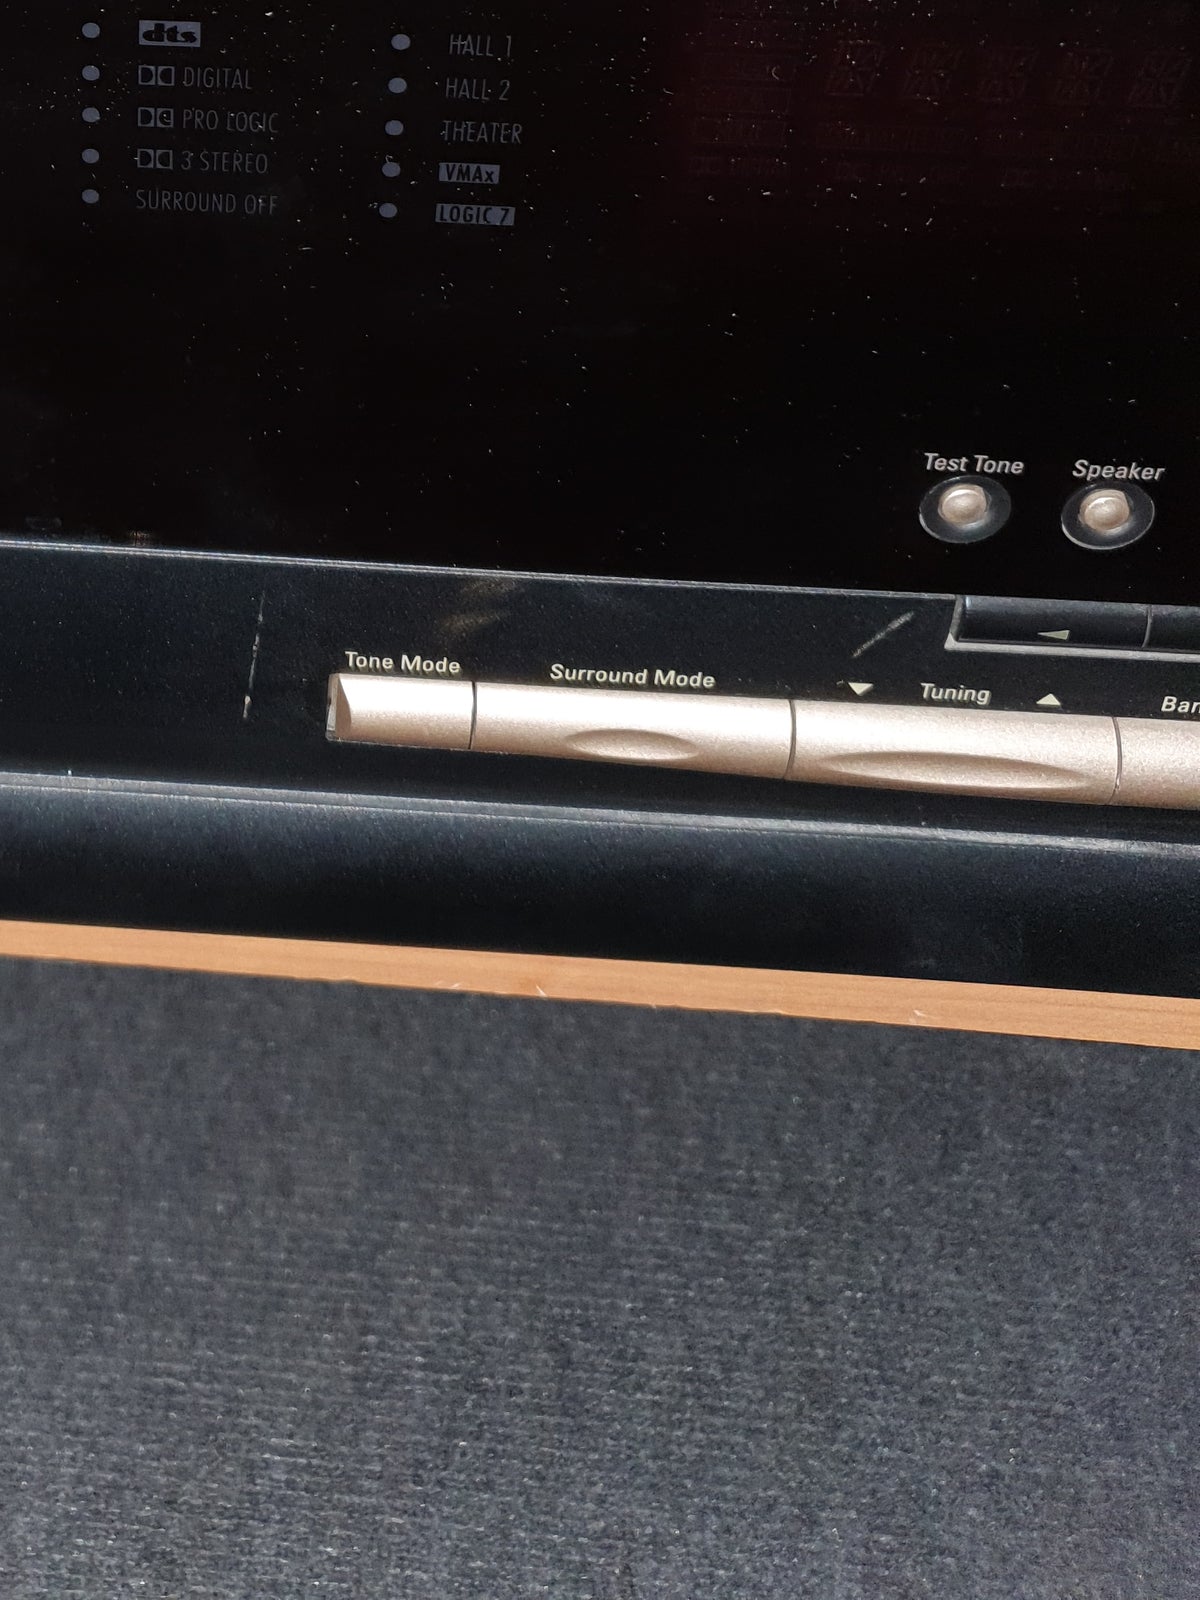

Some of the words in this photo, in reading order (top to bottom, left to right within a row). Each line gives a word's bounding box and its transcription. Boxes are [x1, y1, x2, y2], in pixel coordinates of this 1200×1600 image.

[142, 22, 198, 43] dts
[449, 33, 494, 57] HALL
[505, 35, 512, 57] 1
[183, 67, 252, 89] DIGITAL
[445, 77, 490, 100] HALL
[499, 79, 510, 101] 2
[182, 109, 219, 131] PRO
[227, 111, 279, 133] LOGIC
[441, 119, 523, 144] THEATER
[181, 150, 192, 170] 3
[200, 151, 268, 174] STEREO
[136, 189, 237, 213] SURROUND
[244, 194, 279, 215] OFF
[439, 205, 493, 224] LOGIC
[499, 207, 511, 224] 7
[924, 452, 969, 473] Test
[973, 455, 1025, 475] Tone
[1072, 459, 1166, 482] Speaker
[344, 650, 394, 672] Tone
[401, 653, 461, 675] Mode
[549, 662, 647, 686] Surround
[654, 668, 716, 689] Mode
[920, 682, 991, 705] Tuning
